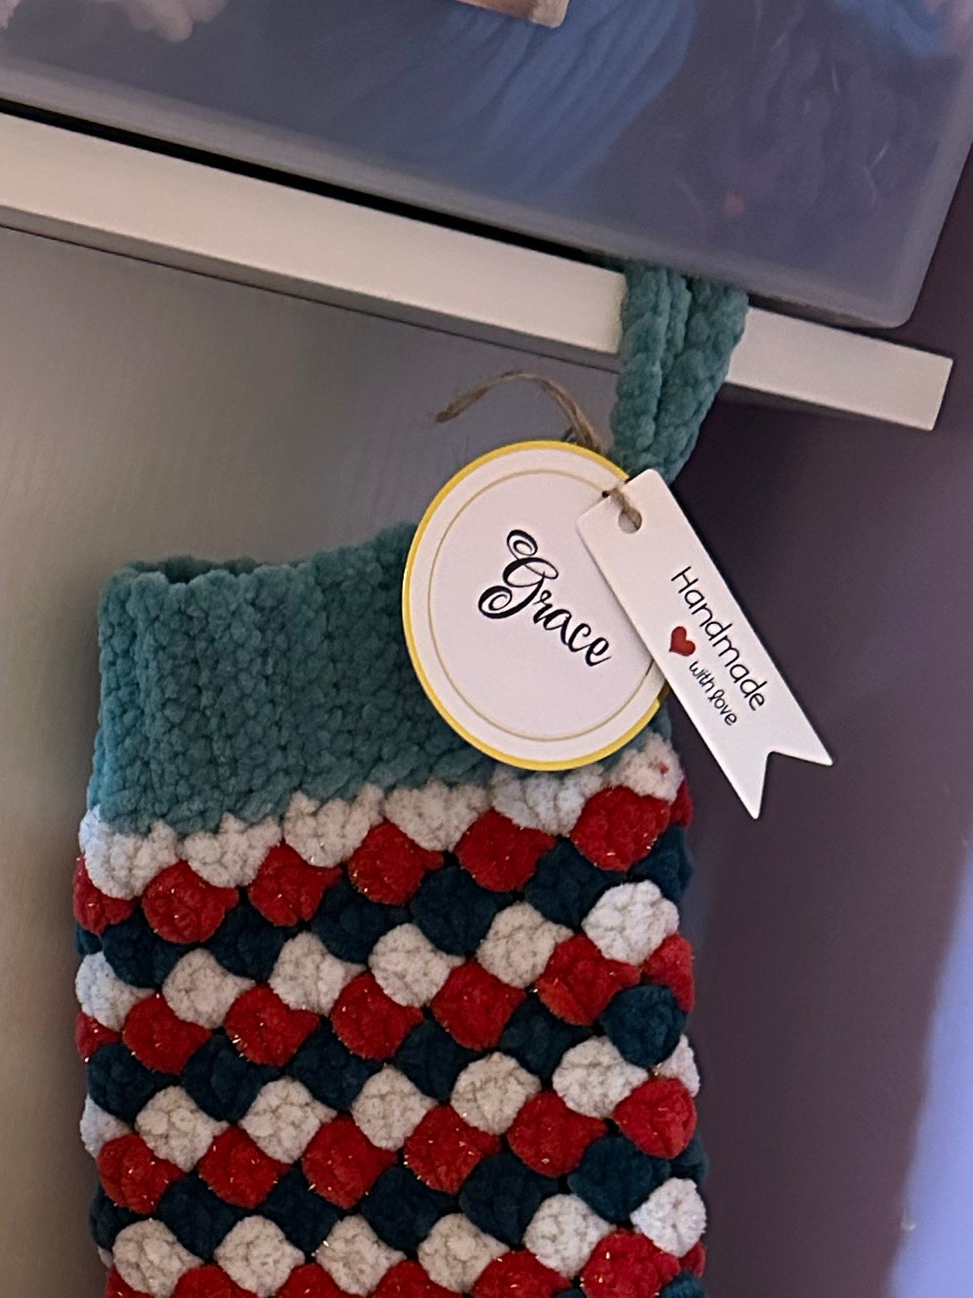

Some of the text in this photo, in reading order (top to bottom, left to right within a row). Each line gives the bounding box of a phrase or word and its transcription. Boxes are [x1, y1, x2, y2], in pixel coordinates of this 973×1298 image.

[477, 528, 612, 668] Grace
[670, 565, 768, 712] Handmade
[688, 660, 738, 727] with love
